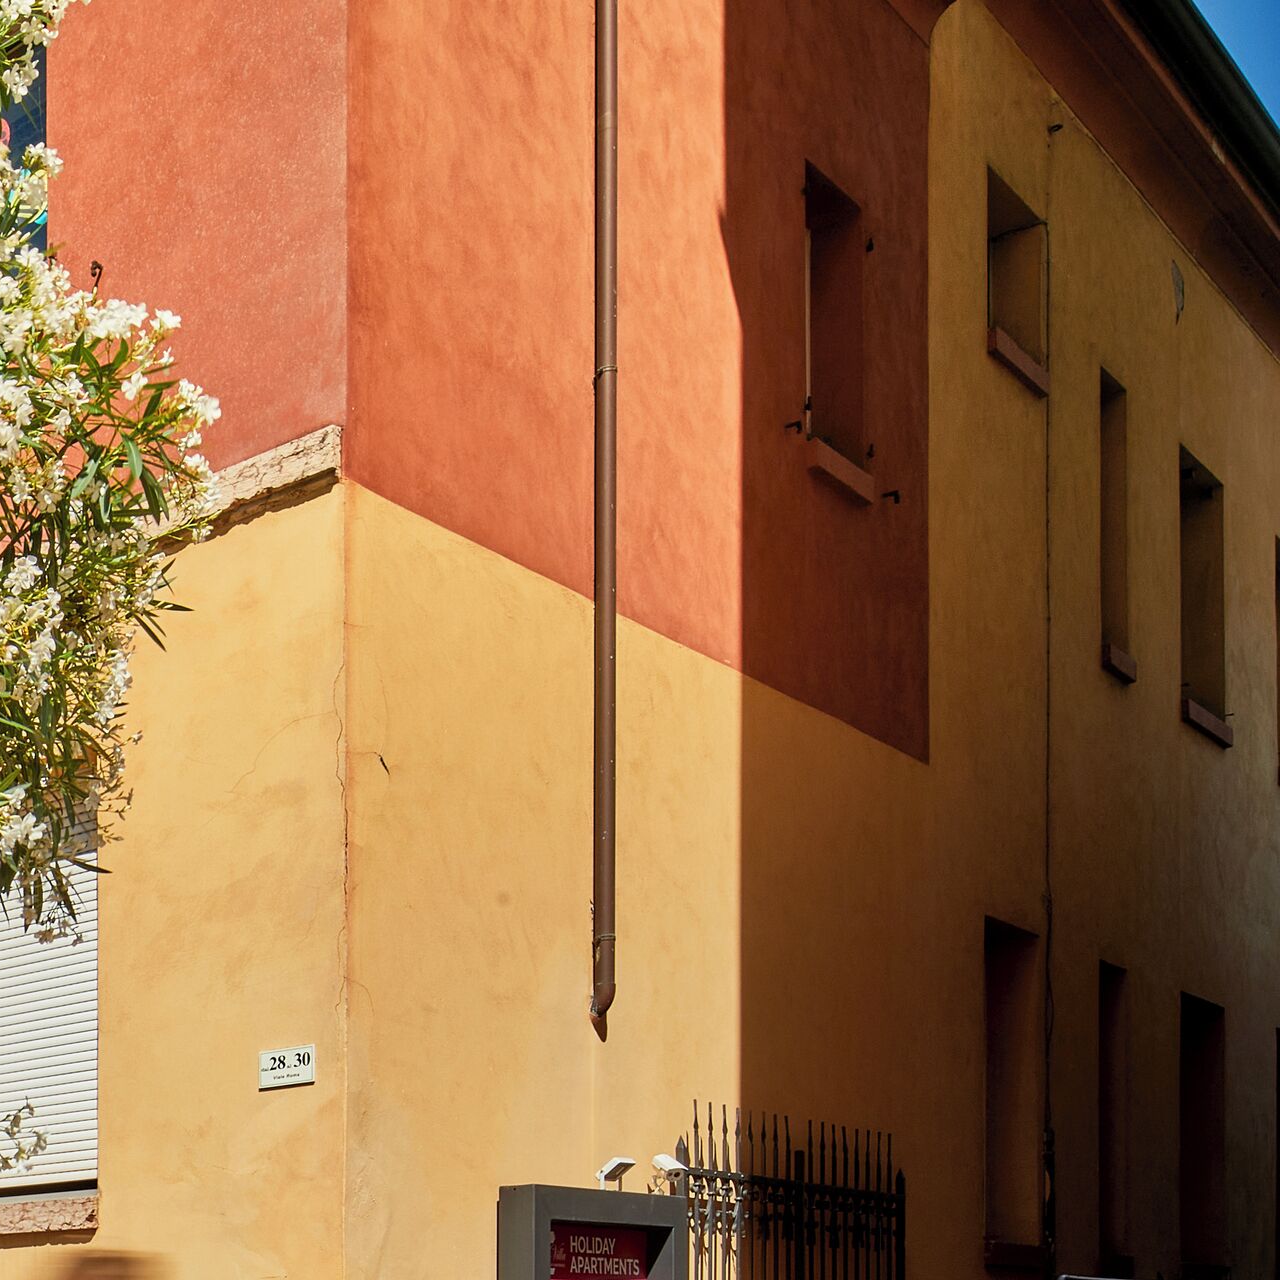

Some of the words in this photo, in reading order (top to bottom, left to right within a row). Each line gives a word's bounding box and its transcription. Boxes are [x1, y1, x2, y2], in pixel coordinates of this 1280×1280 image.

[269, 1055, 286, 1071] 28
[293, 1051, 311, 1068] 30
[570, 1235, 616, 1255] HOLIDAY
[570, 1256, 640, 1276] APARTMENTS
